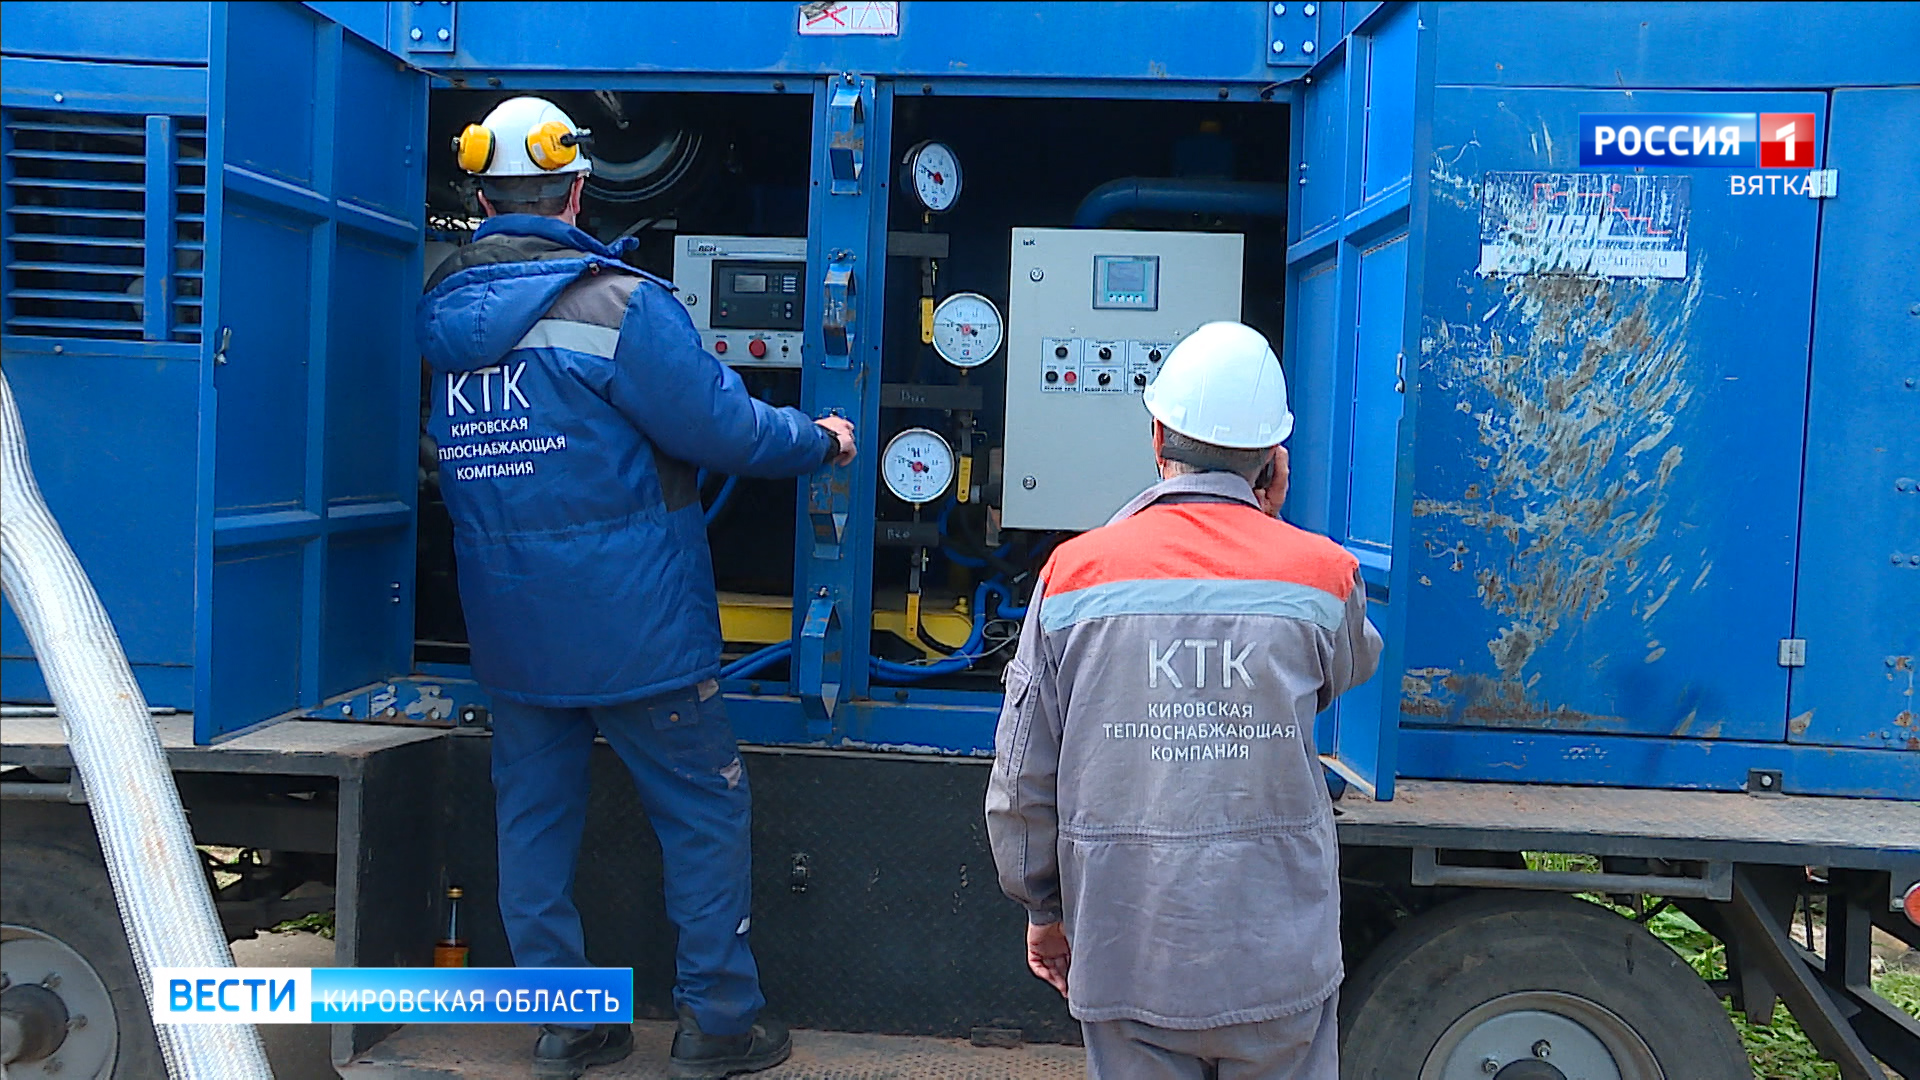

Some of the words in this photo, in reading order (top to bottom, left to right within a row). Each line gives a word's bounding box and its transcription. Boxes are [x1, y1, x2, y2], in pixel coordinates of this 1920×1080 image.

[447, 361, 531, 416] КТК
[451, 417, 529, 437] КИРОВСКАЯ
[438, 435, 567, 460] ПЛОСНАБЖАЮЩАЯ
[456, 461, 534, 481] КОМПАНИЯ
[1148, 639, 1257, 688] КТК
[1148, 701, 1253, 718] КИРОВСКАЯ
[1102, 722, 1296, 740] ТЕПЛОСНАБЖАЮЩАЯ
[1151, 743, 1250, 762] КОМПАНИЯ
